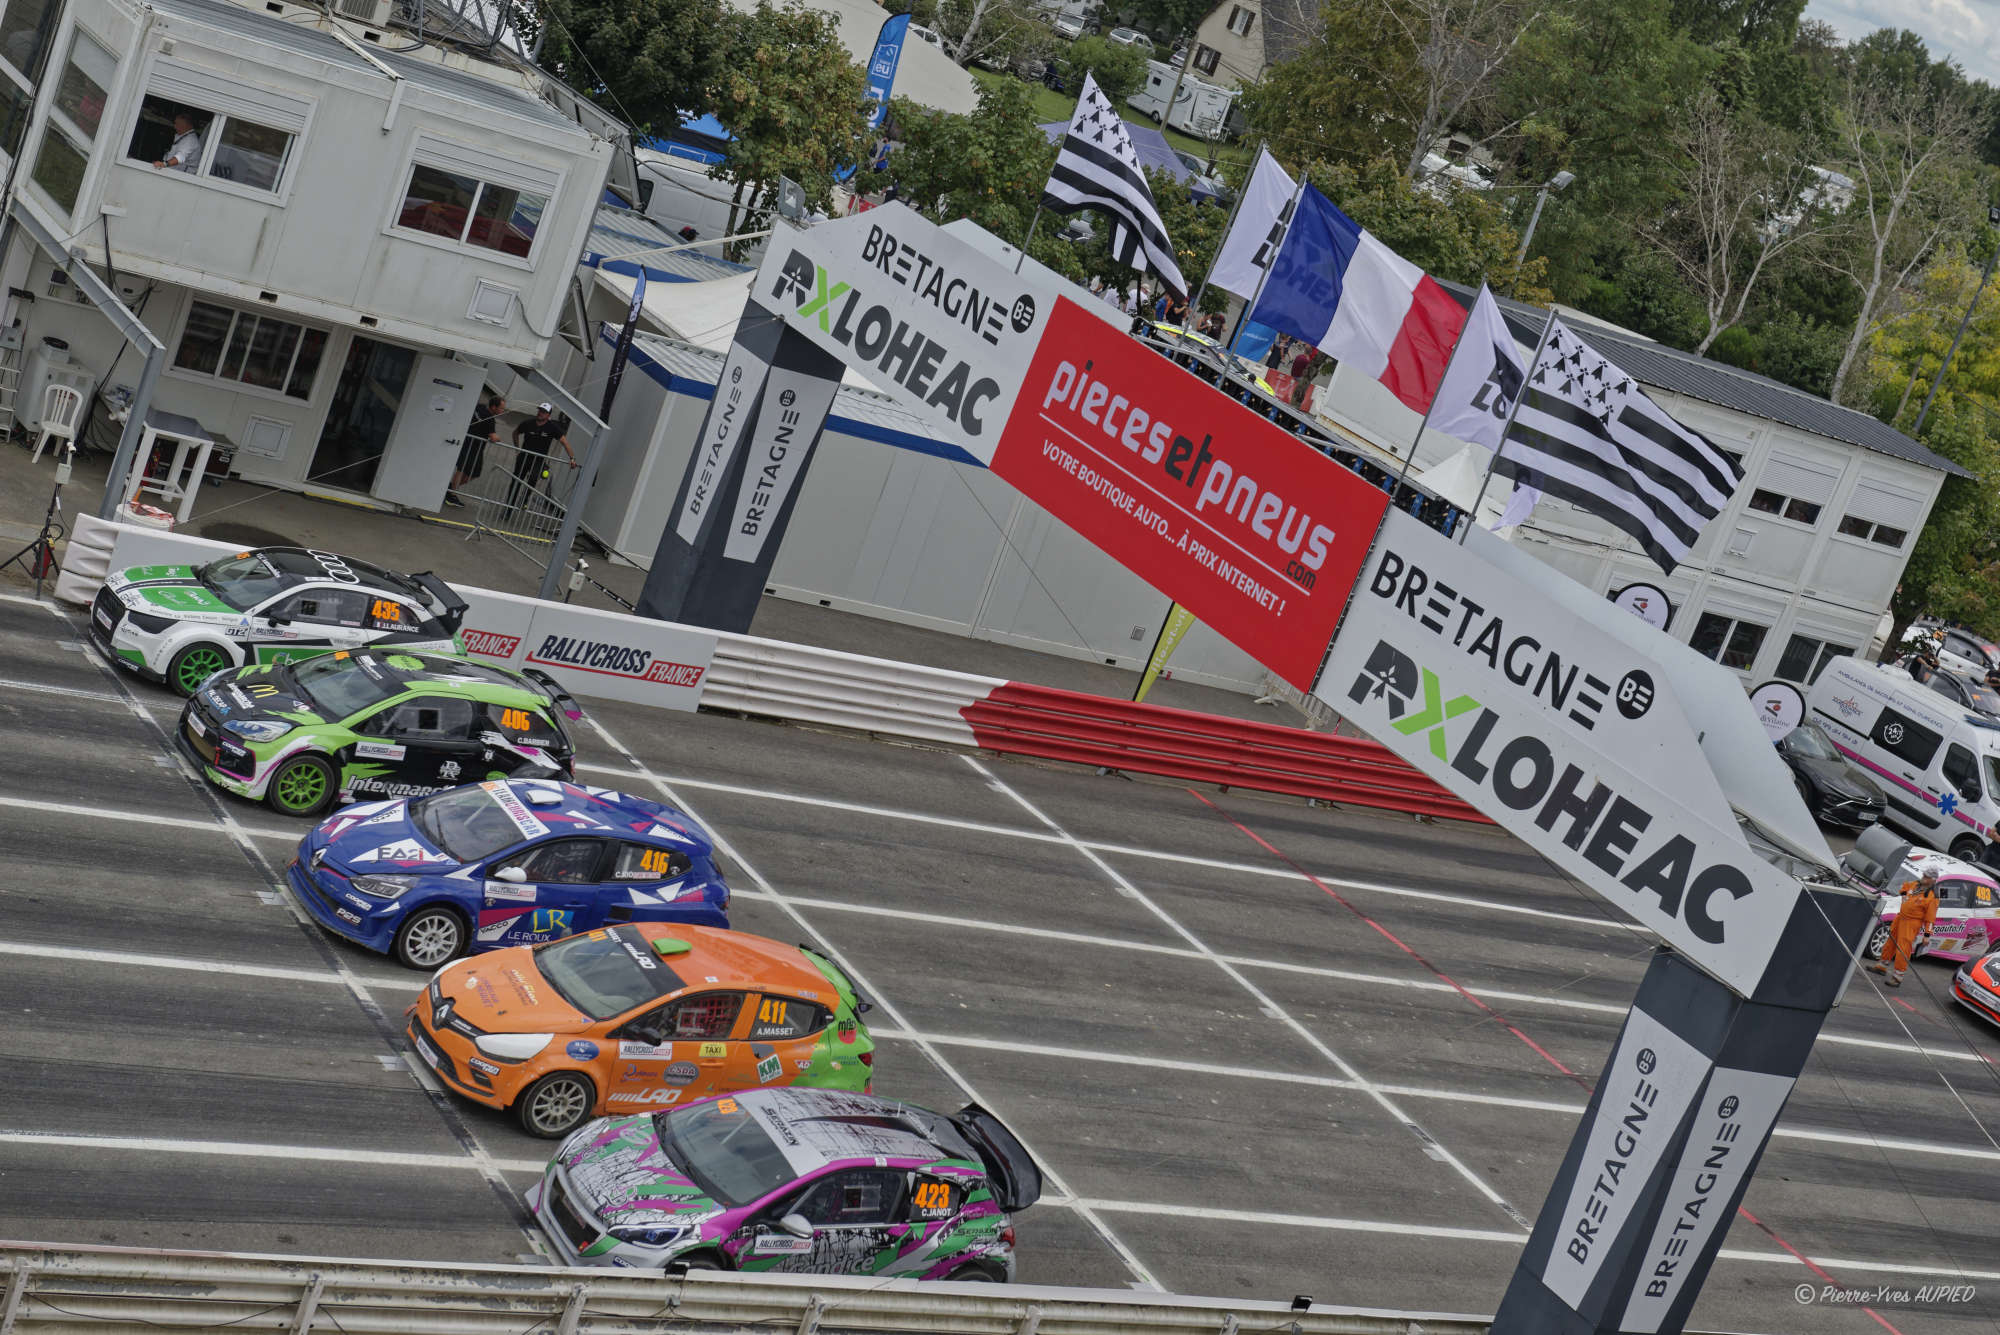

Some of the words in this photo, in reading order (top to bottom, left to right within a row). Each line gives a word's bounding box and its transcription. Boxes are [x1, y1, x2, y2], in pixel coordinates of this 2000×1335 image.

[862, 223, 1008, 346] BRETAGNE
[689, 386, 741, 516] BRETAGNE
[740, 409, 801, 537] BRETAGNE
[1042, 359, 1336, 571] piecesetpneus
[1042, 438, 1076, 475] VOTRE
[1077, 464, 1136, 515] BOUTIQUE
[1133, 503, 1175, 545] AUTO...
[1176, 528, 1190, 550] À
[1187, 540, 1217, 572] PRIX
[1217, 557, 1280, 610] INTERNET
[370, 599, 400, 622] 435
[462, 630, 518, 658] FRANCE
[1369, 549, 1611, 731] BRETAGNE
[537, 634, 652, 674] RALLYCROSS
[650, 662, 703, 687] FRANCE
[501, 708, 530, 732] 406
[640, 849, 670, 874] 416
[1976, 886, 1991, 902] 493
[507, 931, 521, 940] LE
[522, 932, 552, 942] ROUX
[759, 999, 787, 1025] 411
[757, 1027, 795, 1036] A.MASSET
[705, 1046, 723, 1054] TAXI
[758, 1056, 781, 1077] KM
[1566, 1078, 1660, 1265] BRETAGNE
[914, 1182, 951, 1209] 423
[921, 1208, 952, 1218] C.JANOT
[1644, 1121, 1742, 1298] BRETAGNE
[759, 1239, 793, 1250] RALLYCROSS
